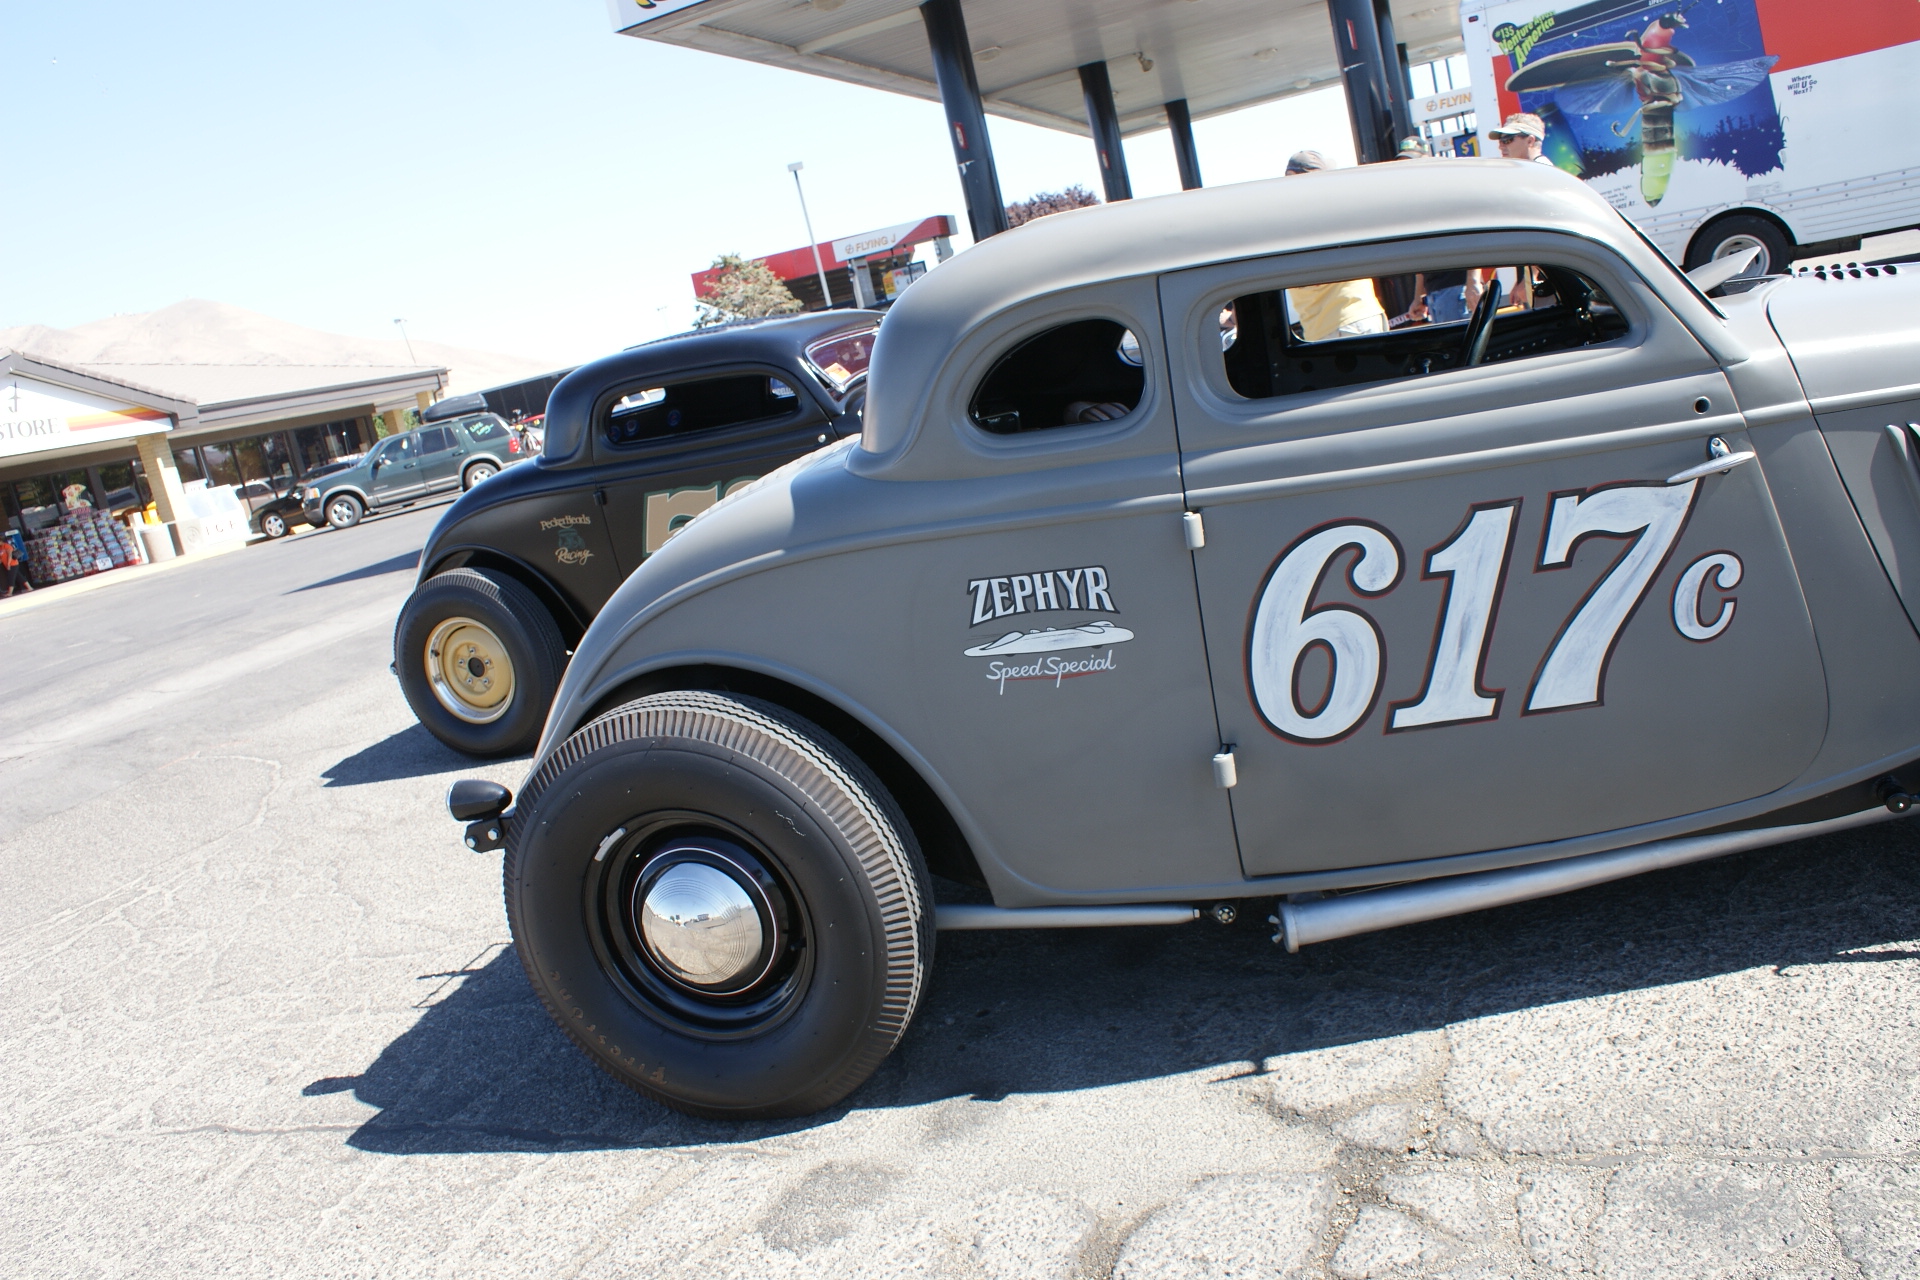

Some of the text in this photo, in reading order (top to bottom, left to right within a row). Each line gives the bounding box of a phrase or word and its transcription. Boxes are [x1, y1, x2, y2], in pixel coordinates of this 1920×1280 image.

[1499, 21, 1534, 56] Venture
[1514, 17, 1555, 70] America
[1791, 74, 1812, 82] Where
[1439, 92, 1472, 110] FLYIN
[855, 233, 897, 252] FLYING J
[555, 547, 594, 565] Racing
[967, 565, 1120, 628] ZEPHYR
[986, 650, 1117, 696] Speed Special
